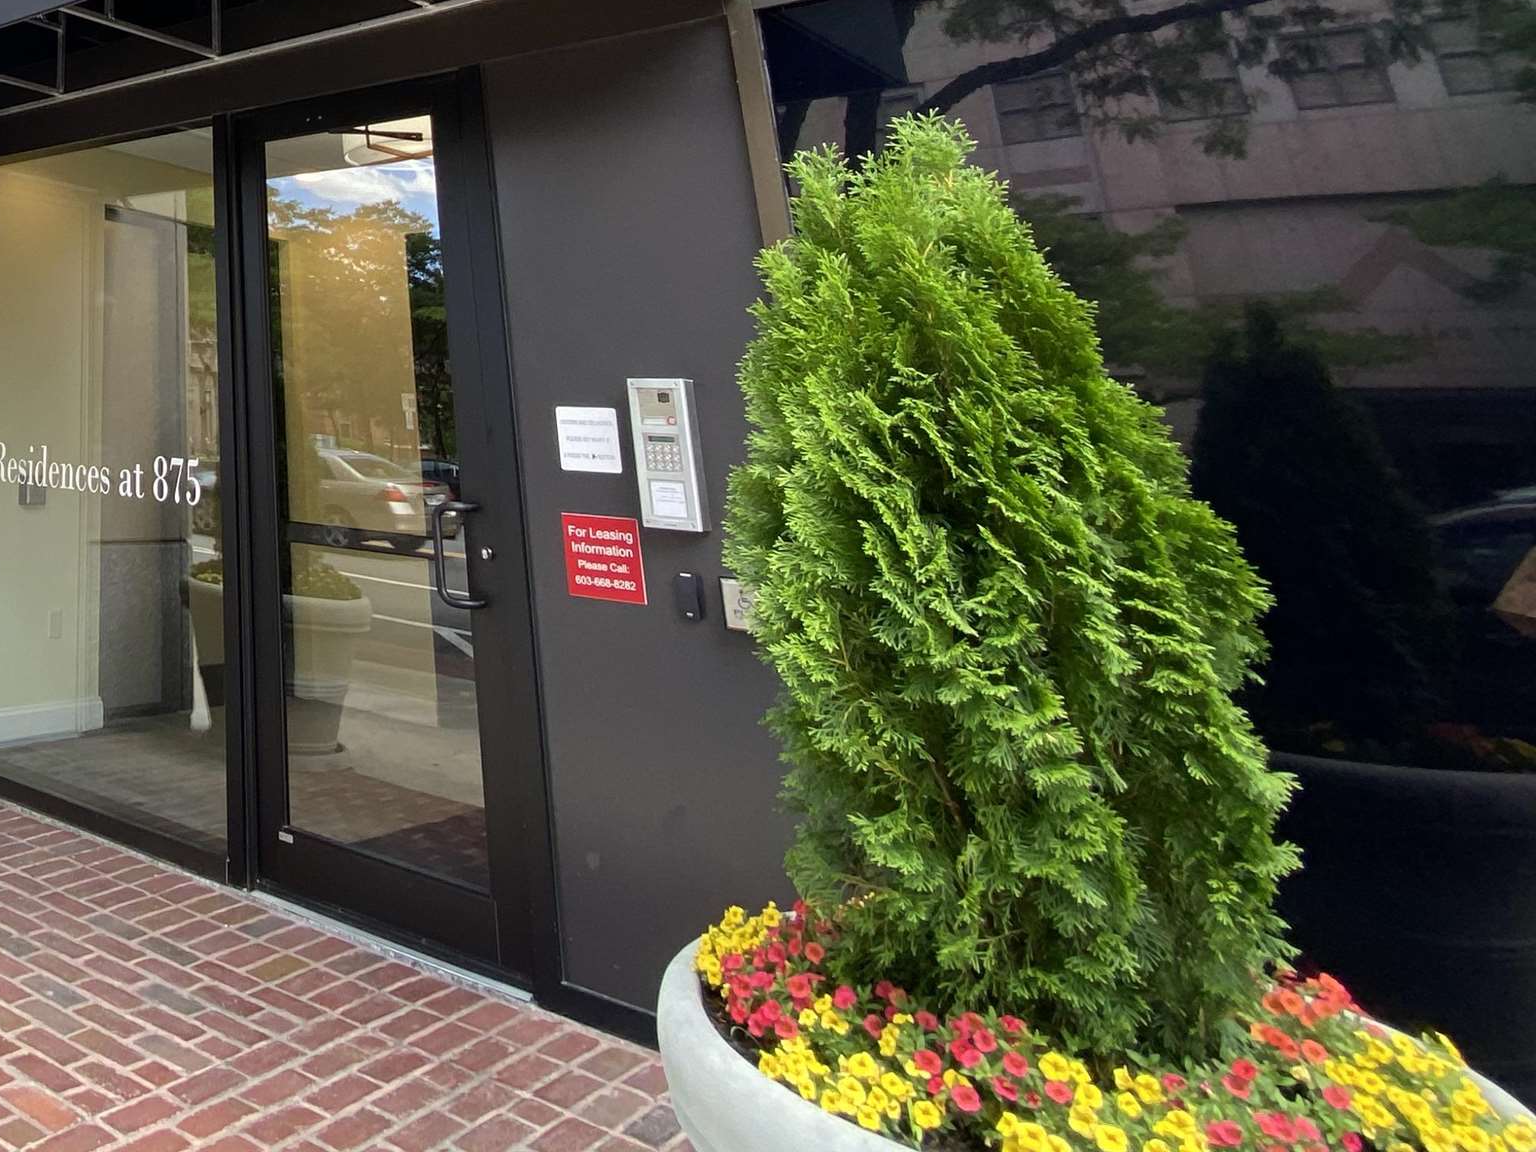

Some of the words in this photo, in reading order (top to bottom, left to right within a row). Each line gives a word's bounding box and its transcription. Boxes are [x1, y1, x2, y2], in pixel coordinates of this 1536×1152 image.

[118, 463, 145, 498] at
[153, 455, 201, 506] 875
[567, 524, 587, 537] For
[589, 527, 633, 545] Leasing
[571, 540, 633, 558] Information
[577, 559, 608, 572] Please
[609, 562, 630, 574] Call:
[575, 574, 637, 591] 603-668-8282
